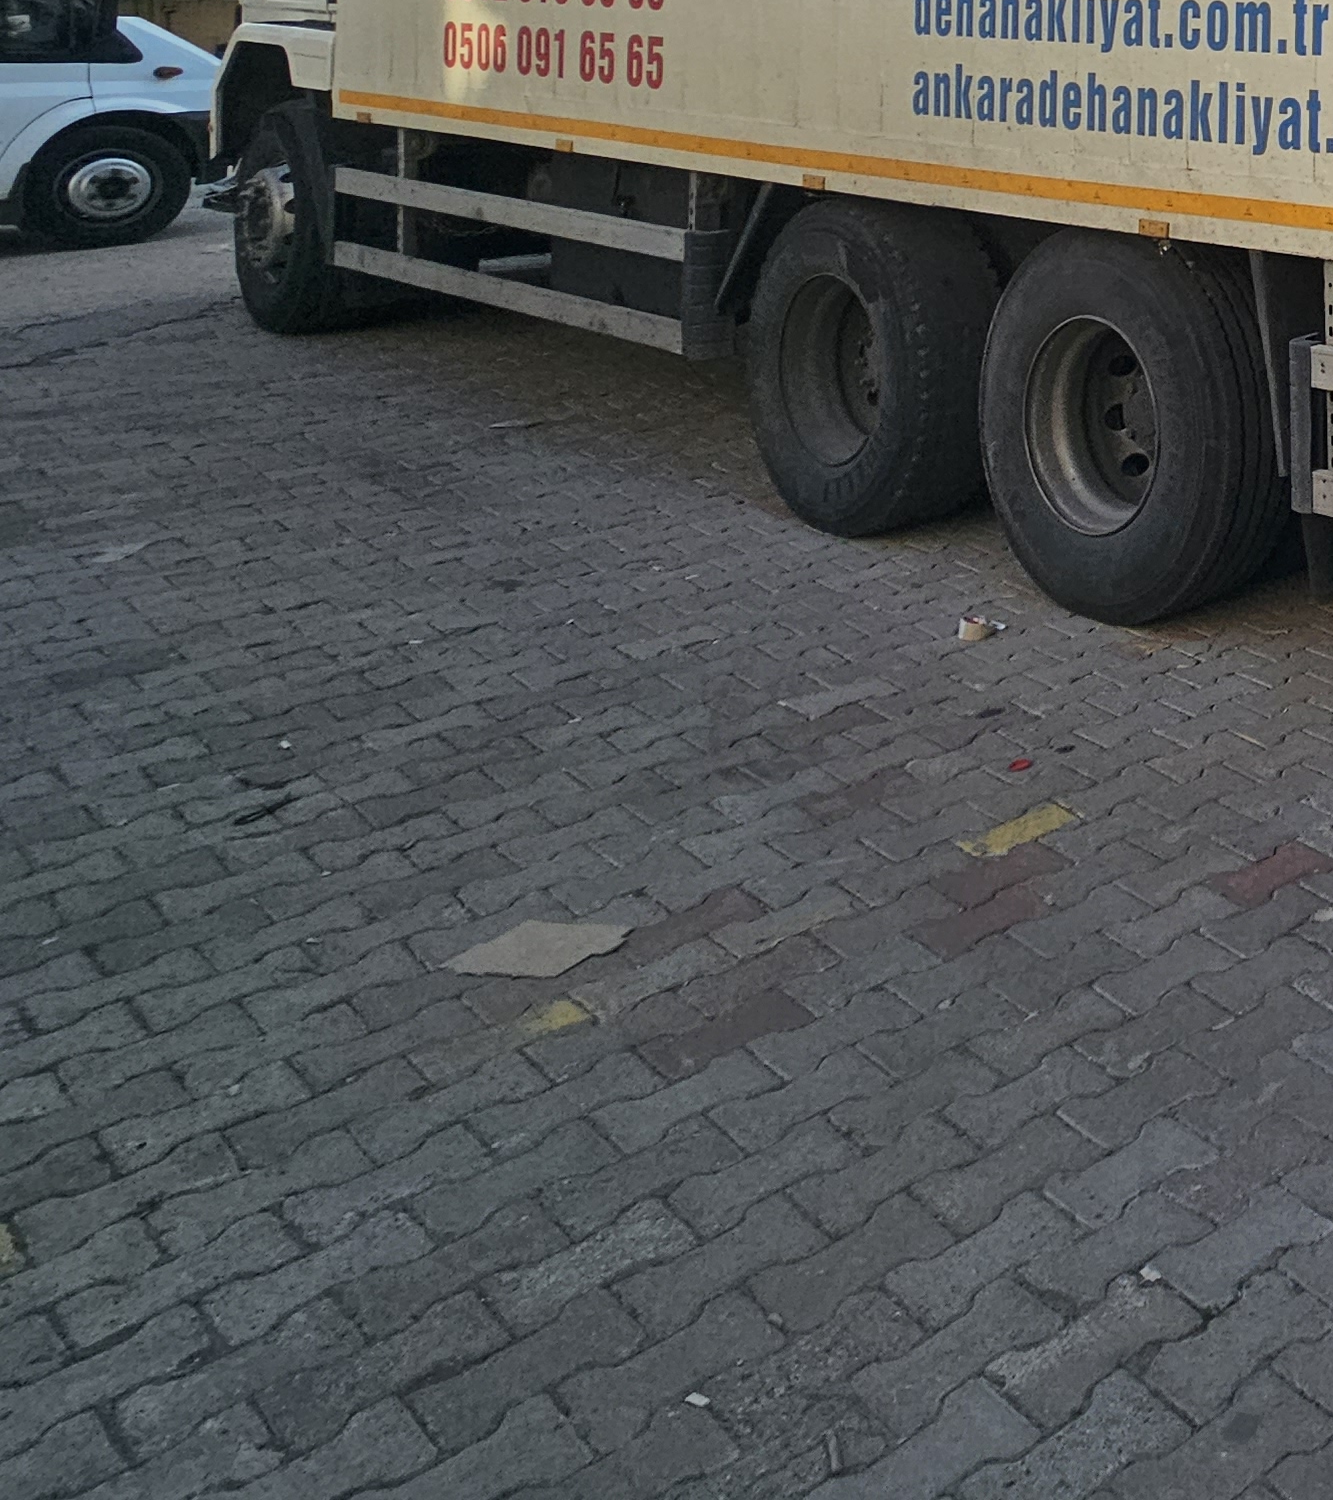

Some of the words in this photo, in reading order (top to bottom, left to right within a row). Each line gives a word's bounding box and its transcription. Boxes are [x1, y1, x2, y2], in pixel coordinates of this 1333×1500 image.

[443, 21, 507, 73] 0506
[516, 25, 565, 79] 091
[579, 30, 615, 84] 65
[627, 34, 664, 90] 65
